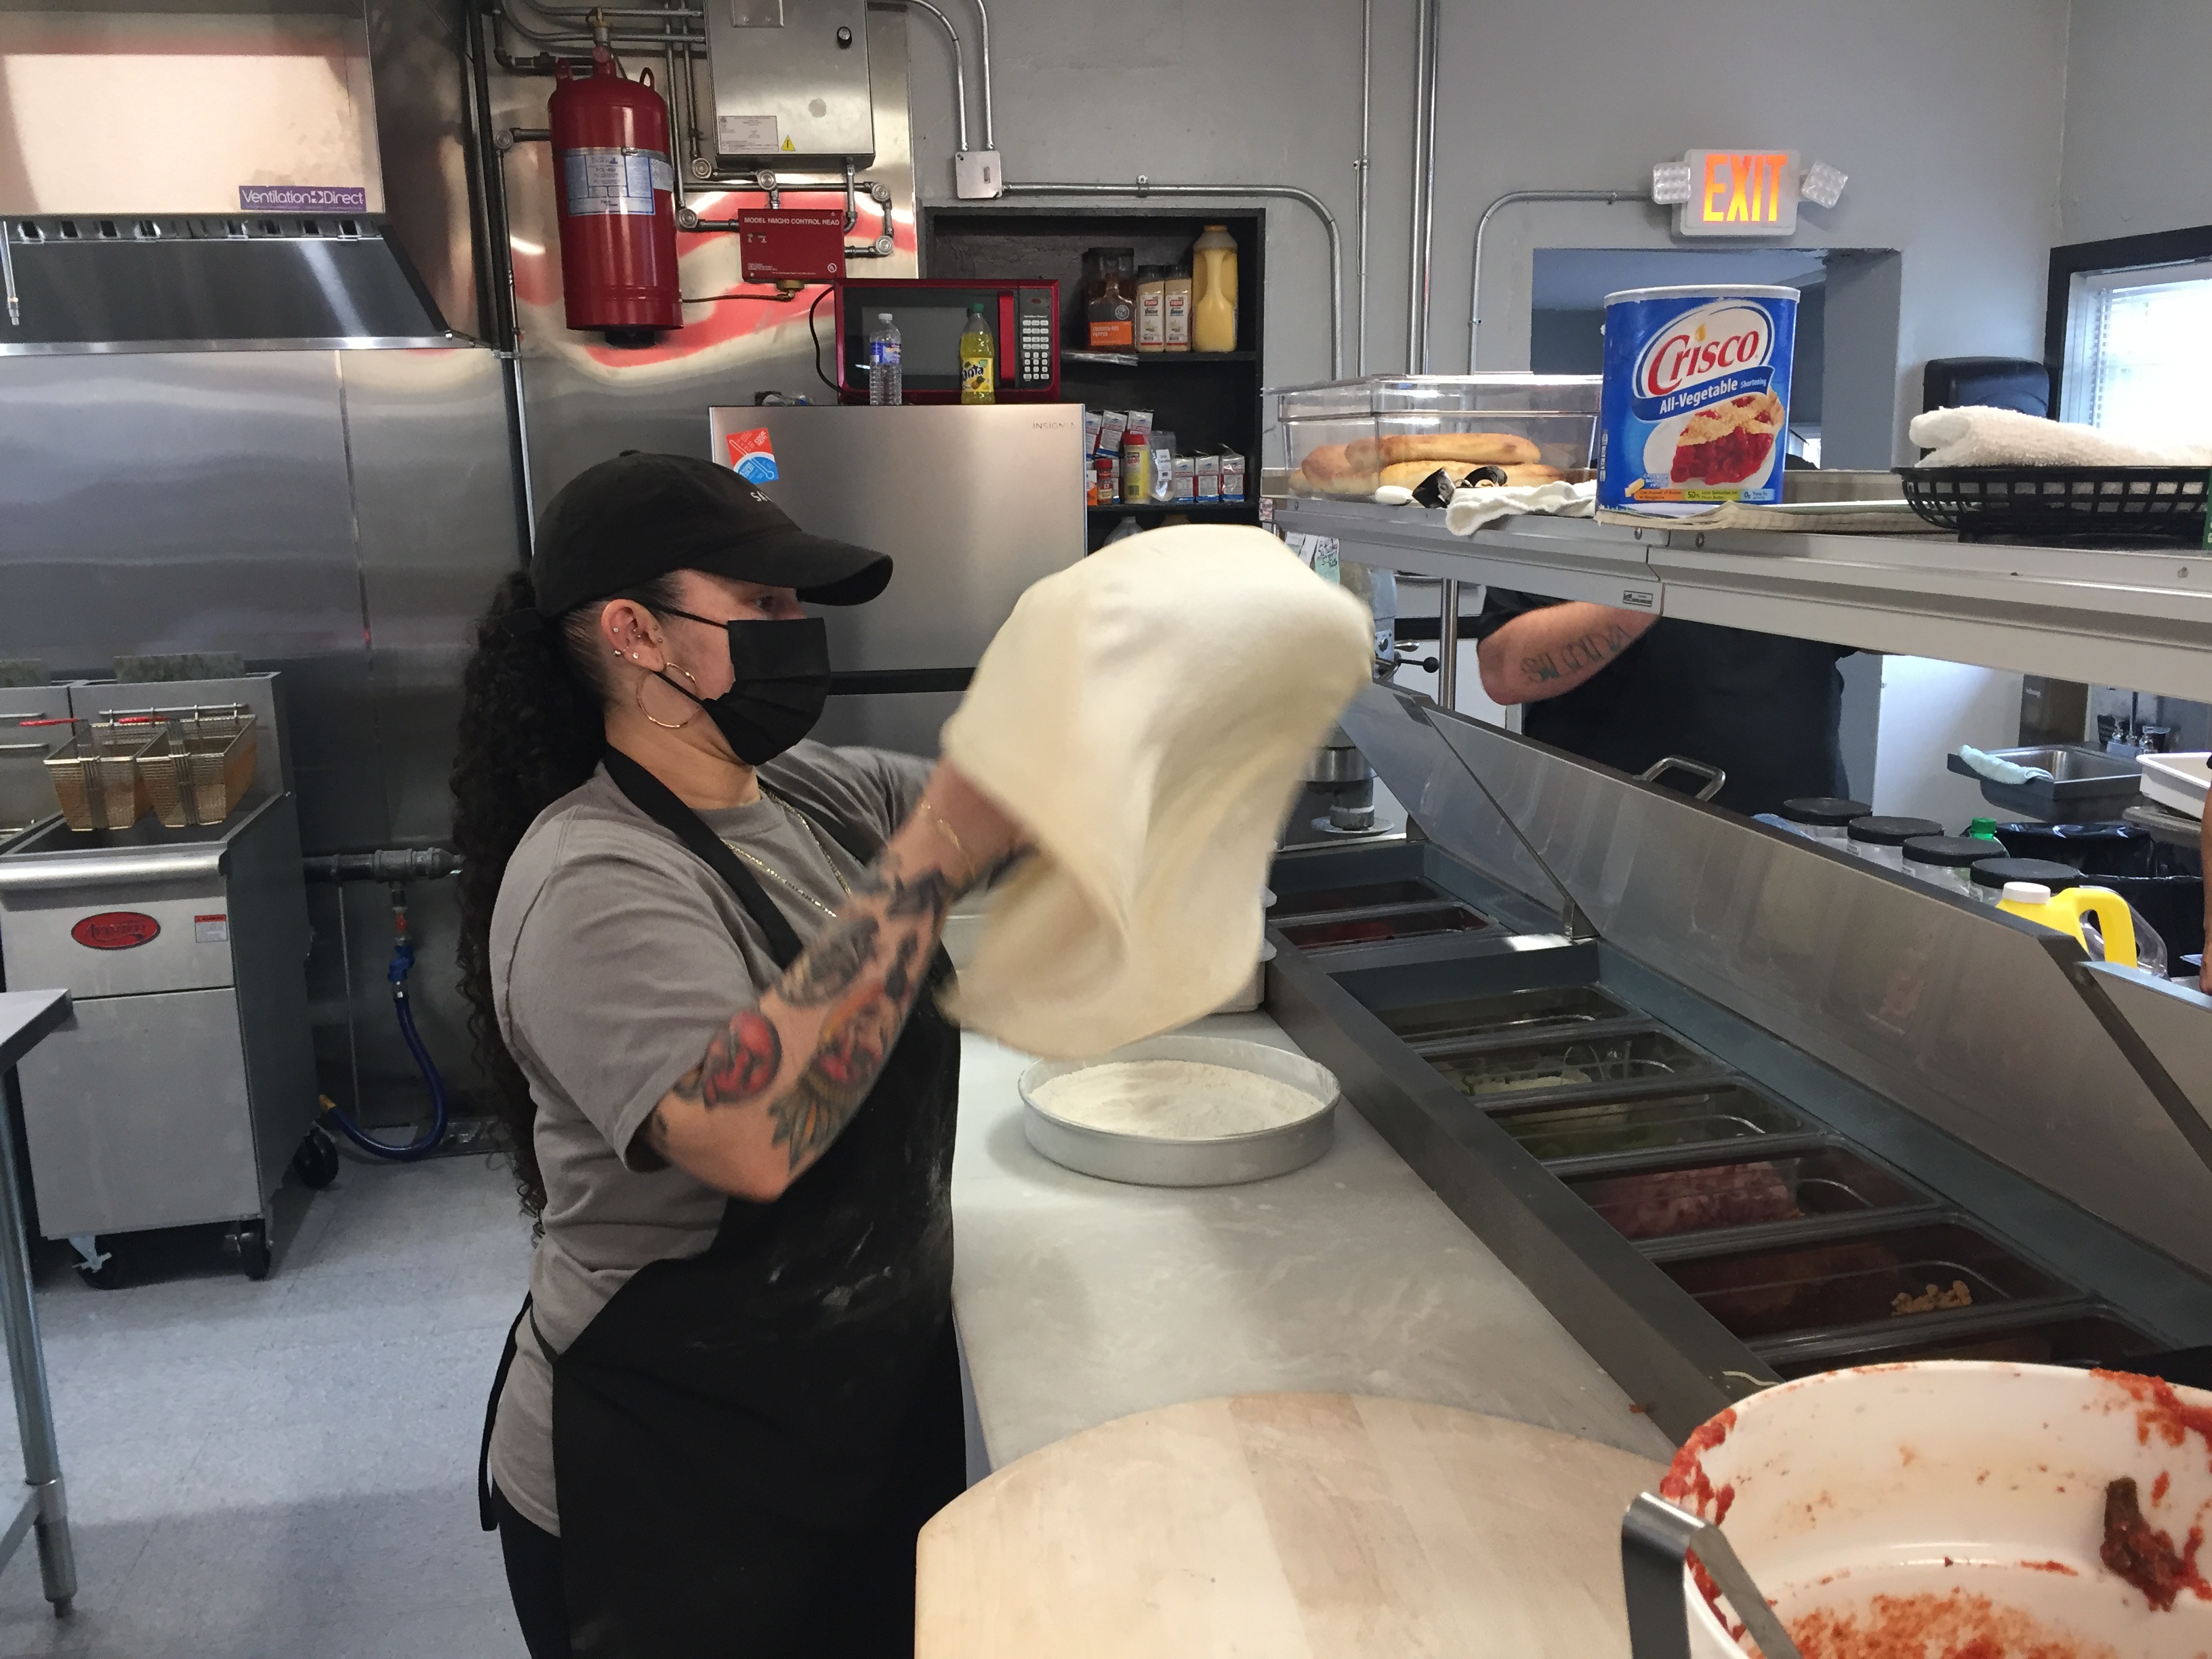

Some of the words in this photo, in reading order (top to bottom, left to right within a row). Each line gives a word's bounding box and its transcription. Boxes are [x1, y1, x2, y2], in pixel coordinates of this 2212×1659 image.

[242, 189, 311, 204] Ventilation
[324, 190, 364, 205] Direct
[1703, 155, 1787, 222] EXIT
[961, 365, 984, 384] anta
[1647, 331, 1759, 396] Crisco
[1659, 377, 1739, 415] All-Vegetable
[1740, 377, 1767, 389] Shortening
